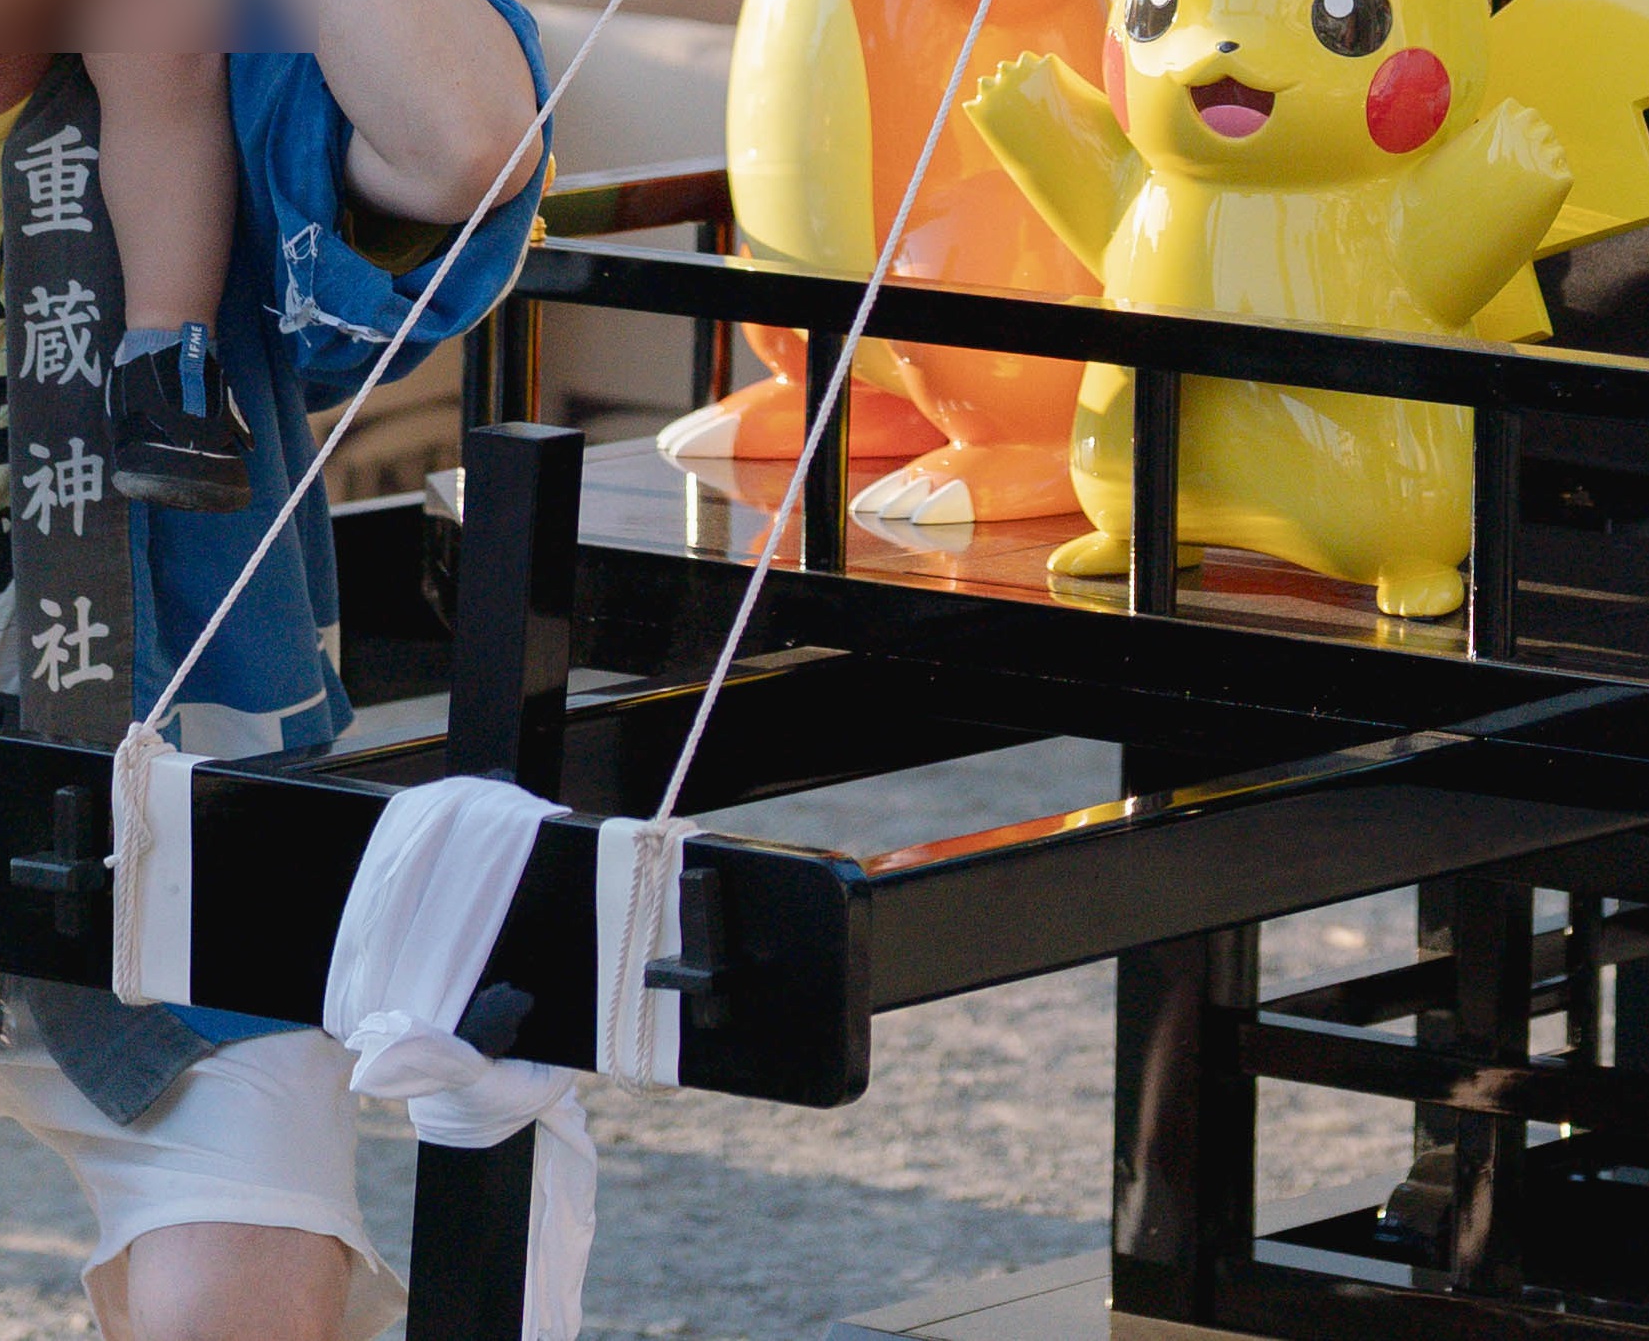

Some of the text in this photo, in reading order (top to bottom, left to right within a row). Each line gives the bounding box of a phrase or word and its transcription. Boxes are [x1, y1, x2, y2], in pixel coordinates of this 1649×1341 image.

[14, 124, 114, 692] 重蔵神社
[188, 325, 203, 359] IFME
